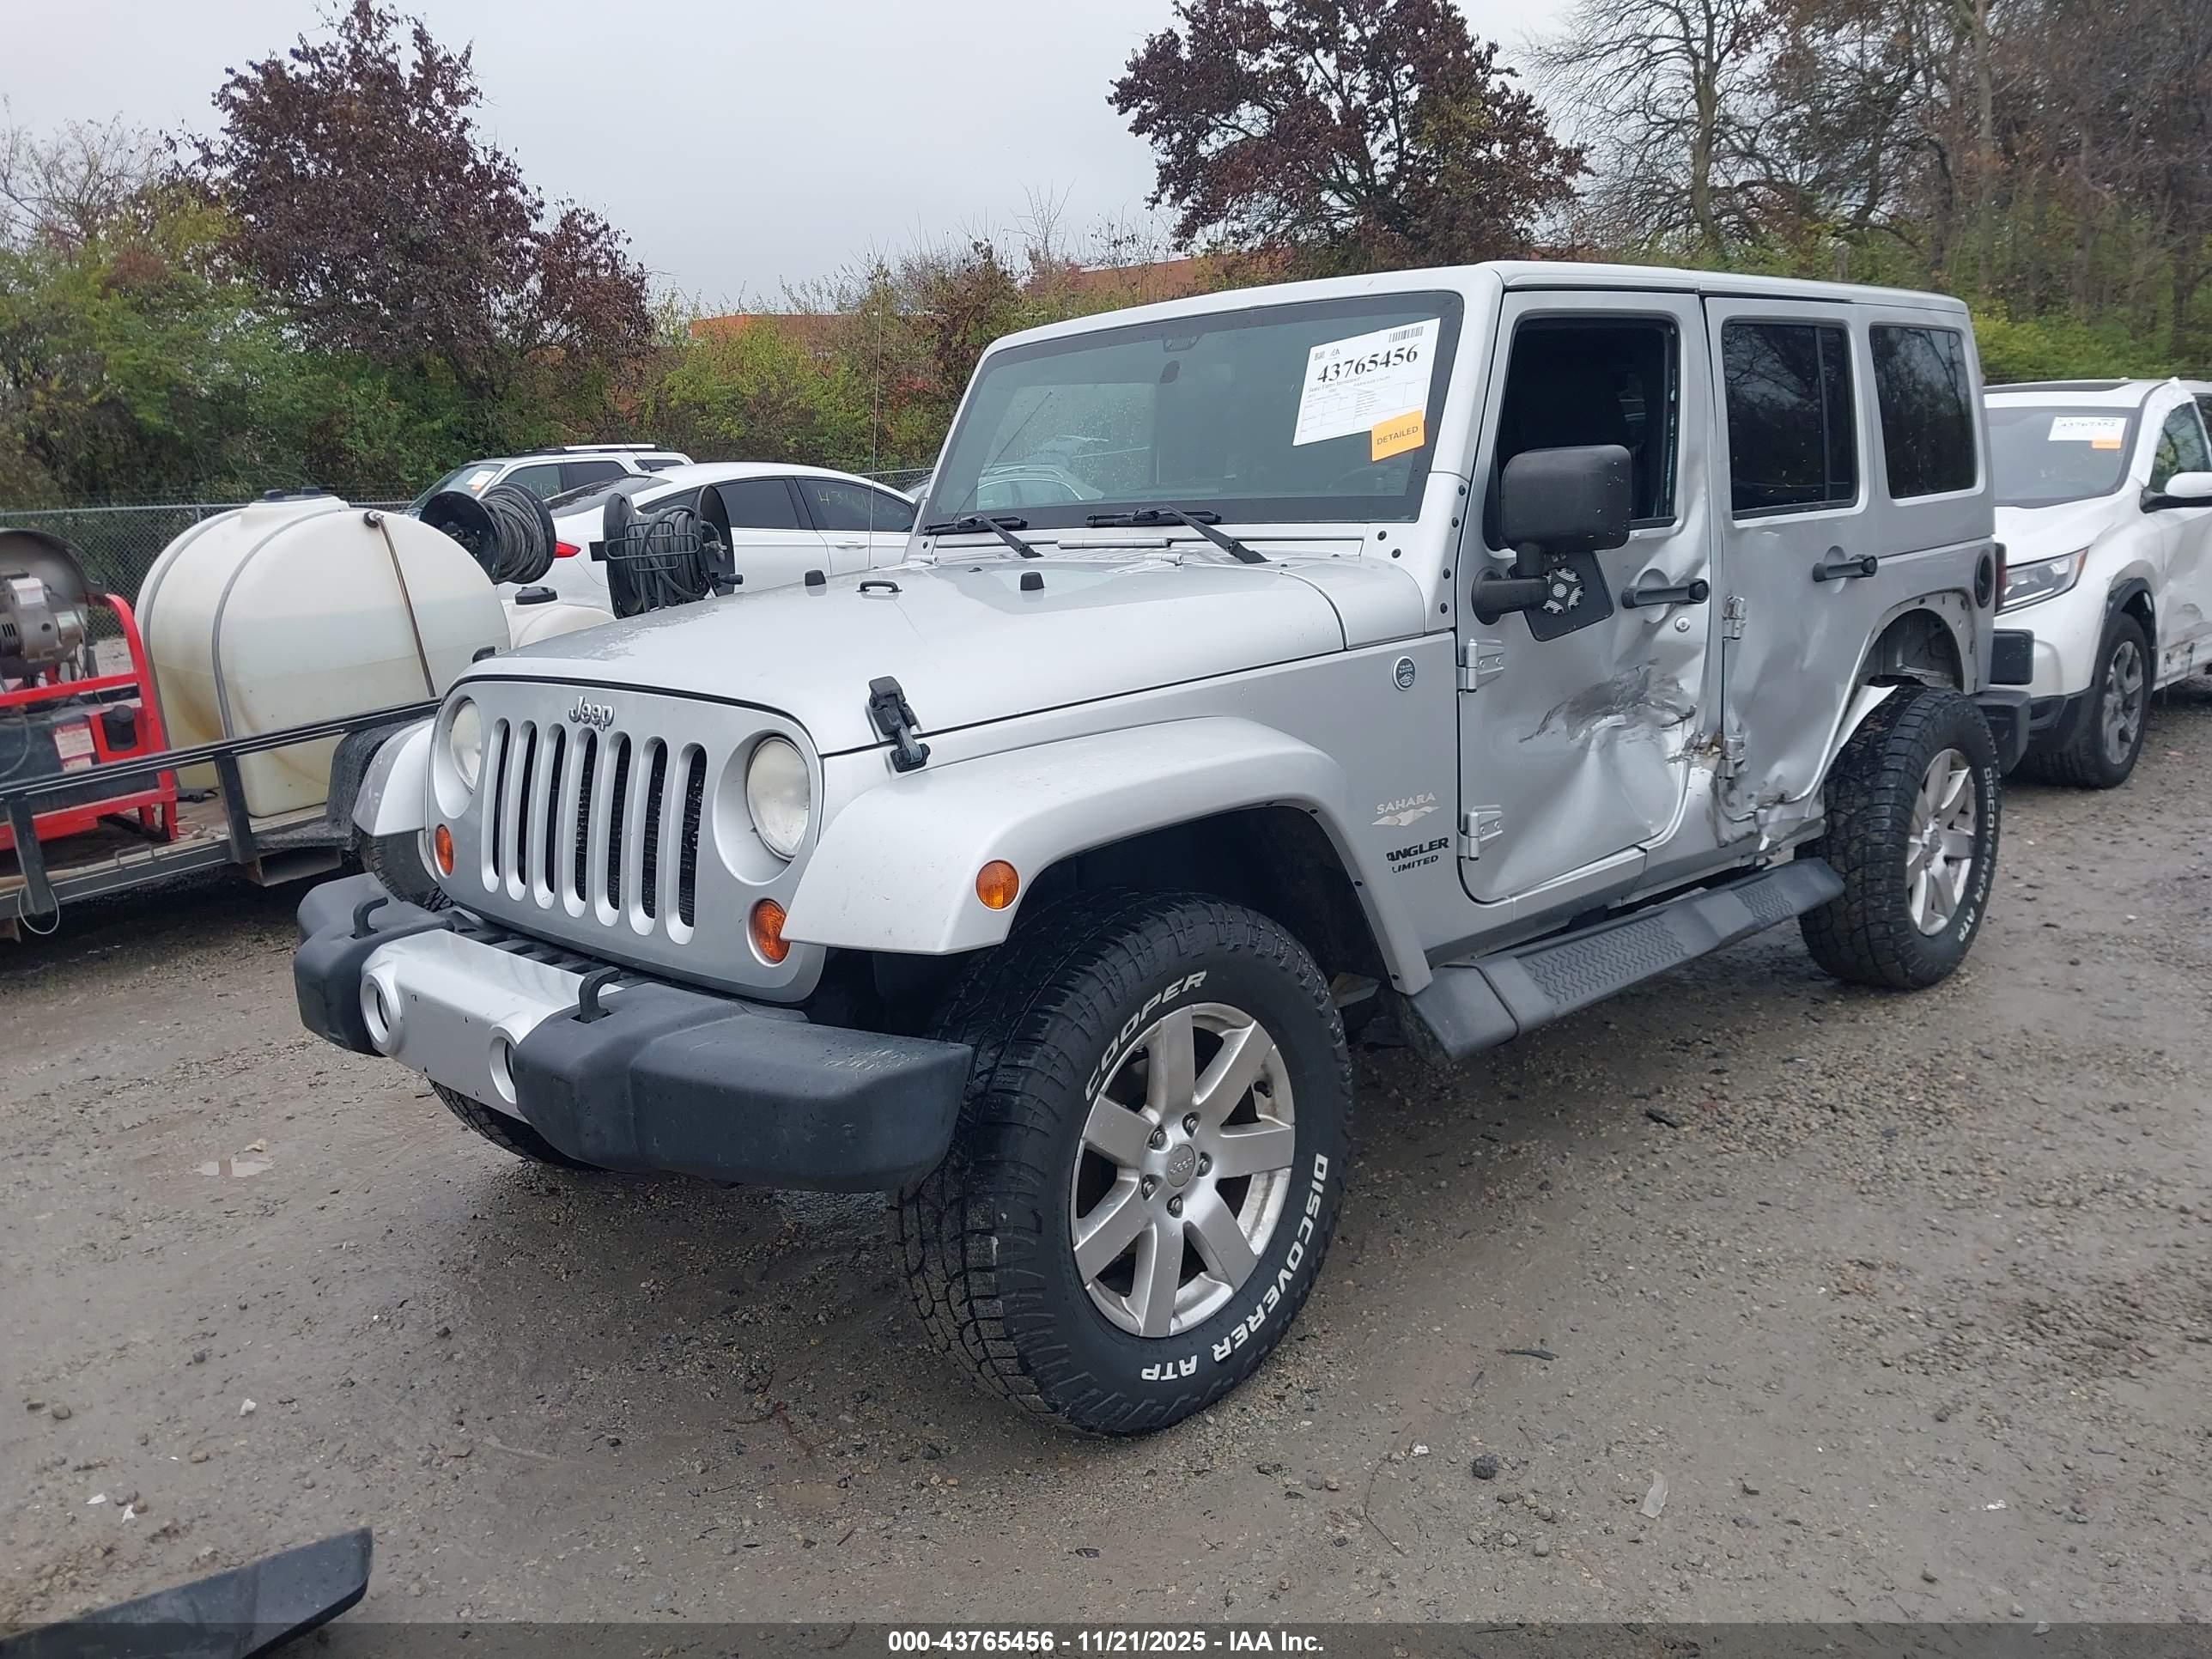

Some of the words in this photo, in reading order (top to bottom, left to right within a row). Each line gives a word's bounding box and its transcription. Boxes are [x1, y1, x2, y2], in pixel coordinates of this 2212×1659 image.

[1317, 343, 1420, 383] 43765456
[1376, 426, 1419, 445] DETAILED
[569, 695, 615, 732] Jeep
[1376, 792, 1436, 815] SAHARA
[1392, 854, 1438, 873] LIMITED
[1085, 969, 1207, 1102] COOPER
[1211, 1153, 1328, 1363] DISCOVERER
[1140, 1354, 1197, 1381] ATP
